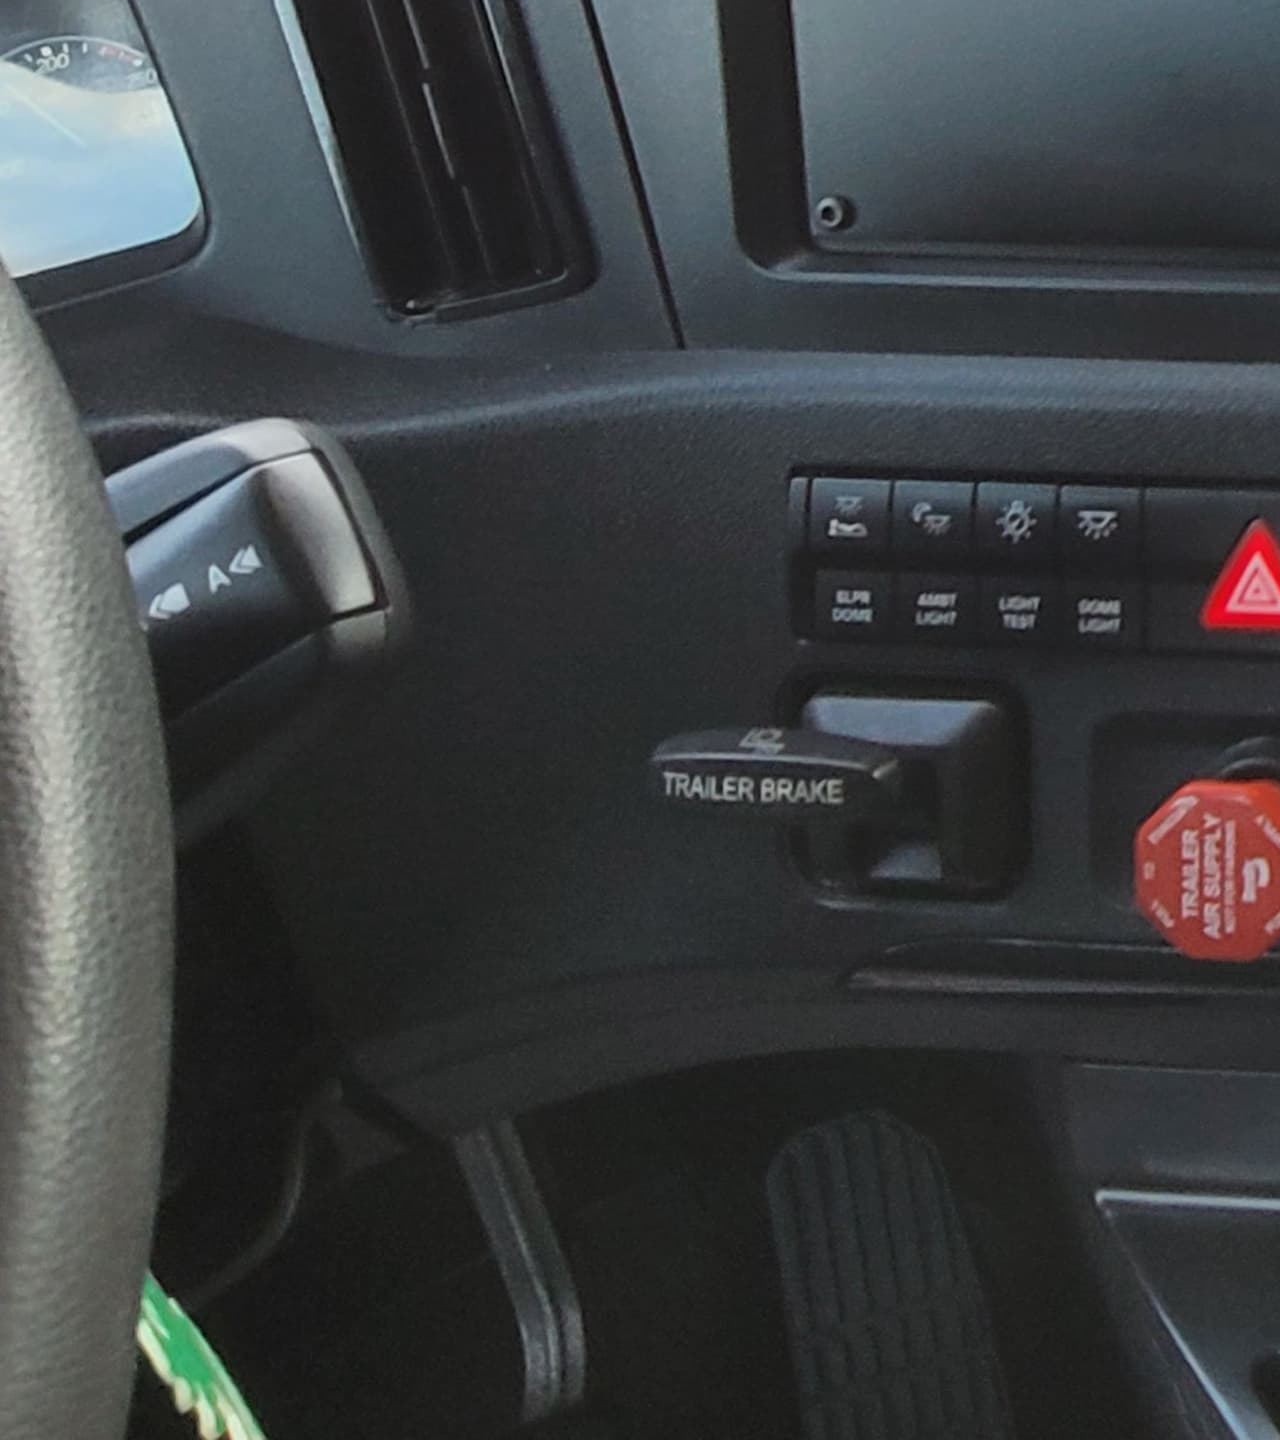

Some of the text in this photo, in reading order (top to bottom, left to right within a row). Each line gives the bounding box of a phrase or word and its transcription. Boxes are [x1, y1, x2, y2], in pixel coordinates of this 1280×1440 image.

[663, 771, 844, 804] TRAILER BRAKE
[1181, 829, 1200, 919] TRAILER
[1203, 812, 1222, 898] SUPPLY
